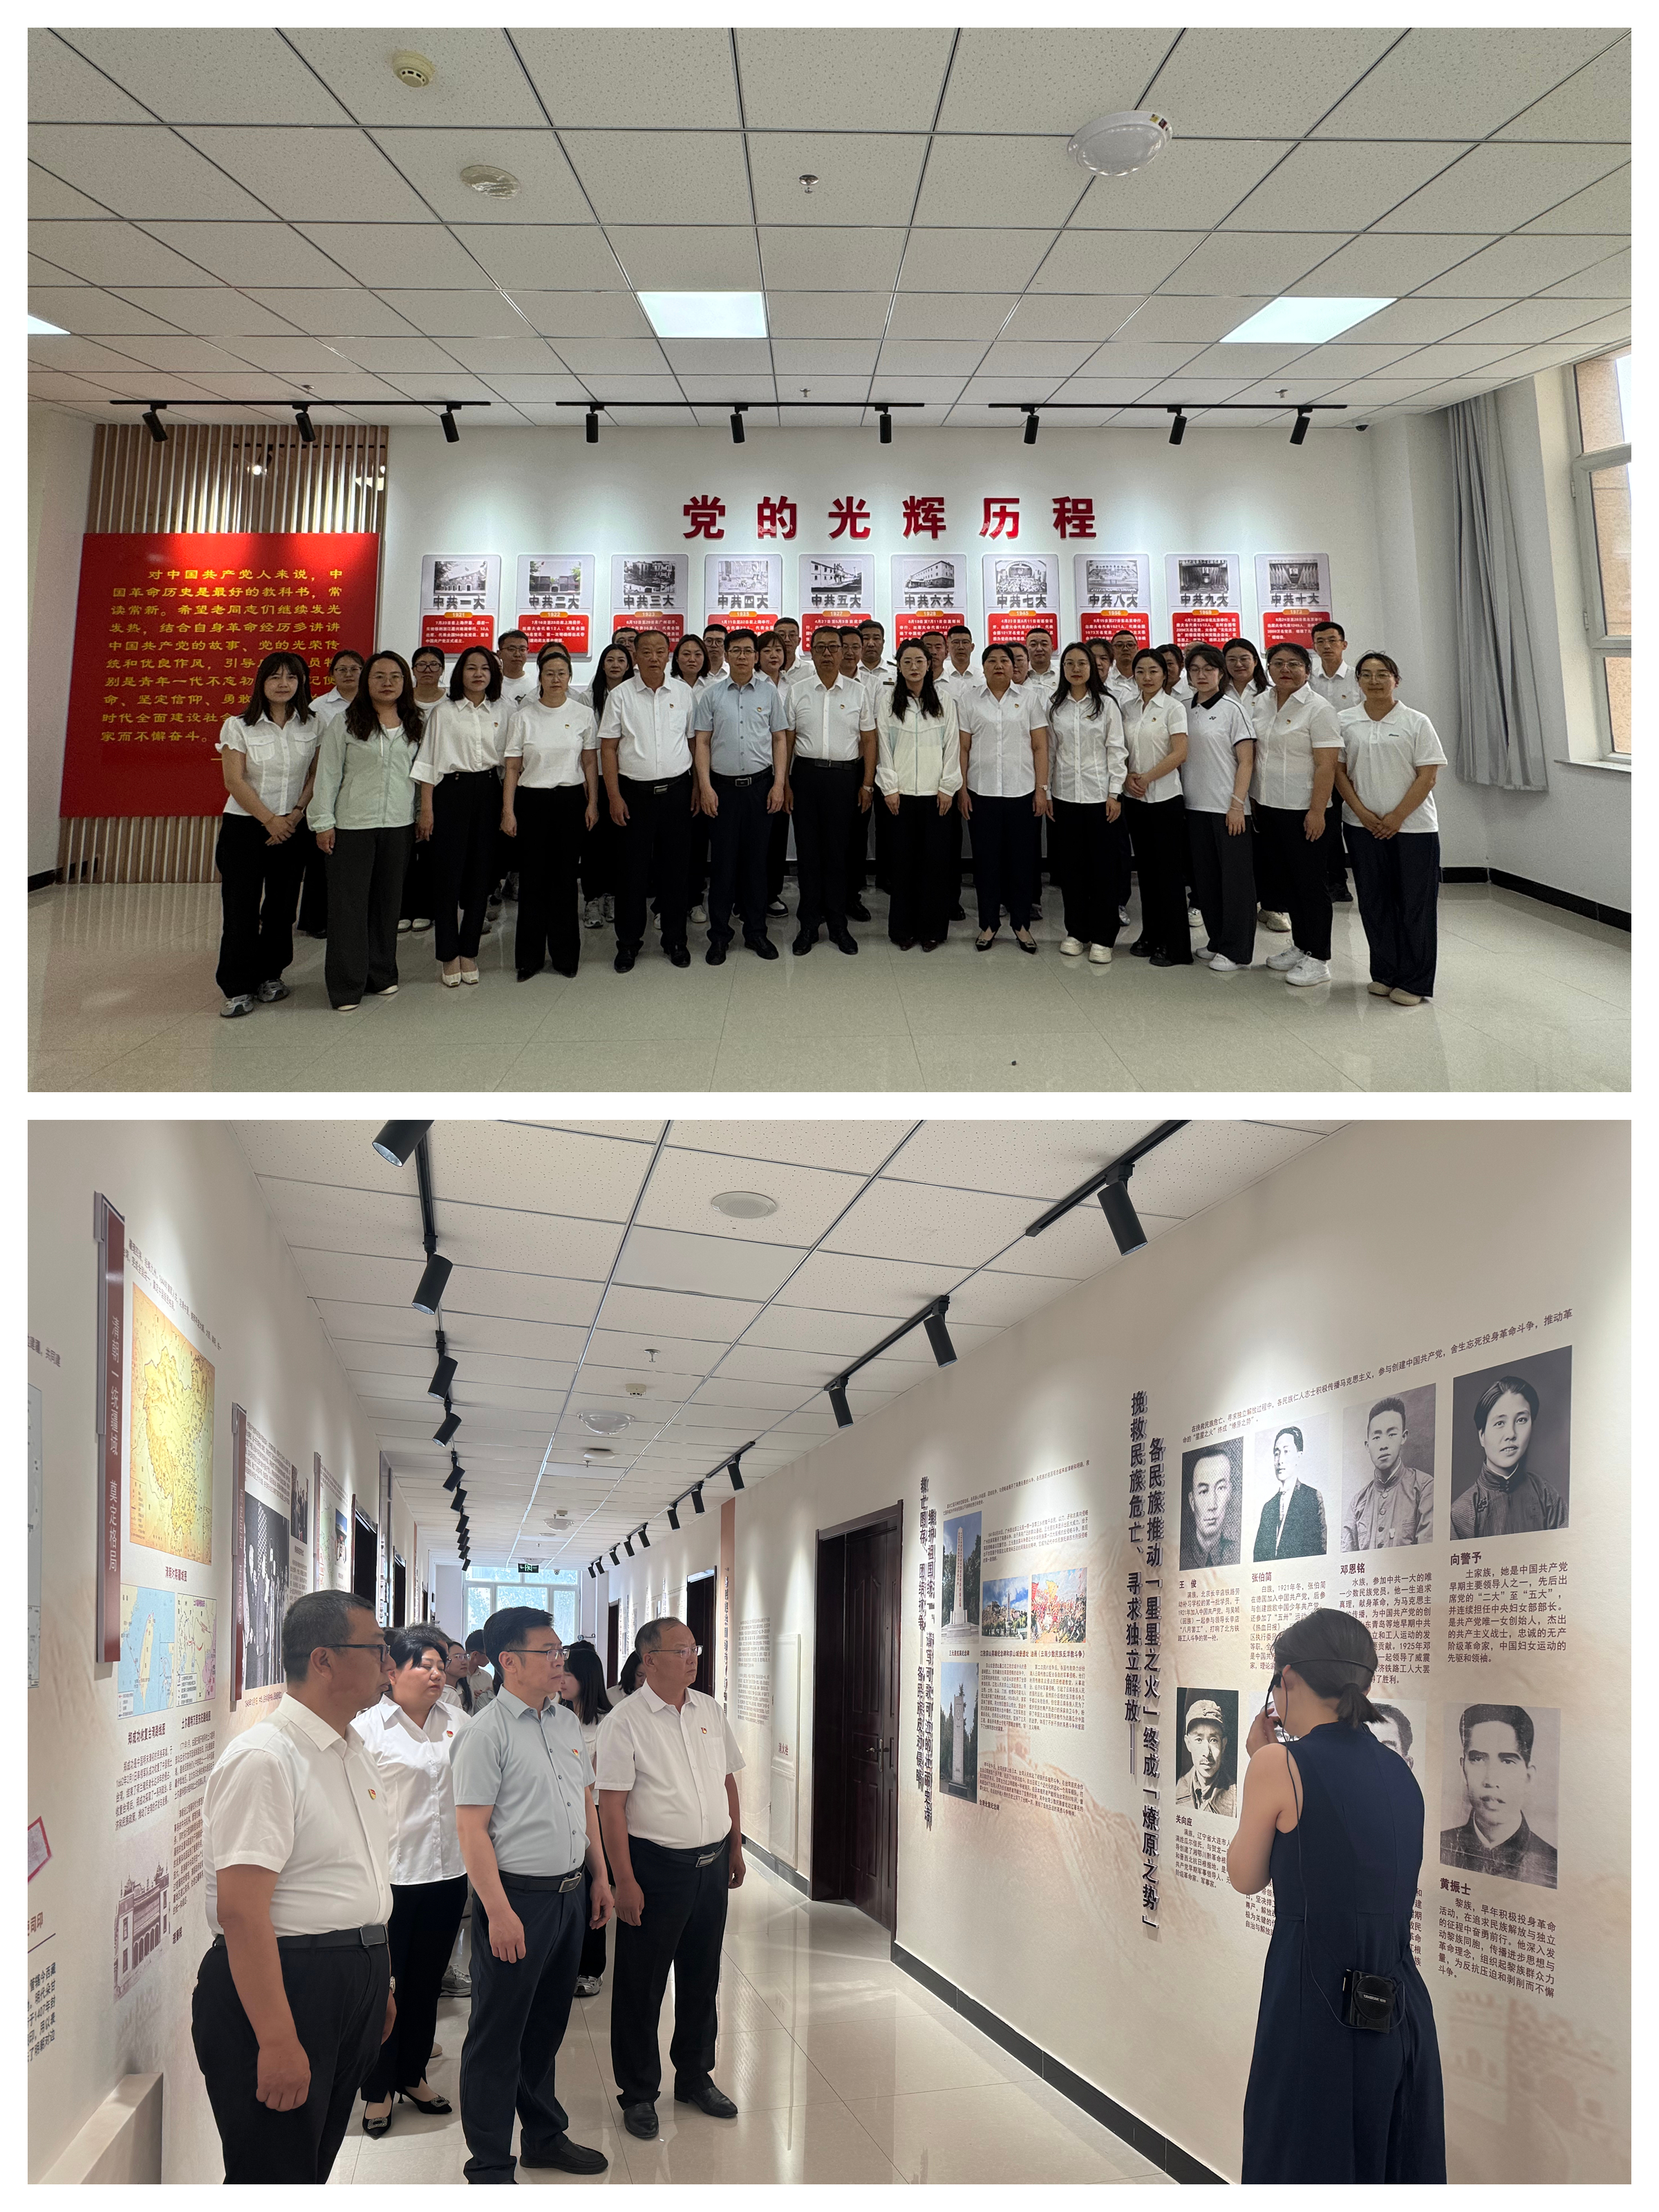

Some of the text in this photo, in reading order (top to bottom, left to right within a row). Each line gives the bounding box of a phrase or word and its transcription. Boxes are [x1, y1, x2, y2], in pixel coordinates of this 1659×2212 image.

[683, 495, 1096, 540] 党的光辉历程
[148, 568, 343, 581] 对中国共产党人来说，中
[113, 586, 342, 599] 国革命历史是最好的教科书，常
[433, 595, 485, 610] 中共一大
[529, 594, 579, 609] 中共二大
[624, 594, 674, 609] 中共三大
[812, 594, 861, 608] 中共五大
[905, 594, 955, 608] 中共六大
[997, 594, 1047, 608] 中共七大
[1089, 594, 1138, 608] 中共八大
[1181, 594, 1228, 608] 中共九大
[1270, 593, 1318, 608] 中共十大
[111, 603, 341, 617] 读常新。希望老同志们继续发光
[109, 621, 340, 635] 发热，结合自身革命经历多讲讲
[109, 639, 339, 653] 中国共产党的故事、党的光荣传
[101, 731, 207, 742] 家而不懈奋斗。
[109, 1480, 118, 1573] 奠定格局
[1450, 1552, 1482, 1566] 向警予
[1340, 1562, 1365, 1575] 邓恩铭
[1465, 1562, 1568, 1578] 土家族，她是中国共产党
[1252, 1572, 1272, 1582] 张伯简
[1352, 1573, 1432, 1586] 水族，参加中共一大的唯
[1450, 1575, 1567, 1591] 早期主要领导人之一，先后出
[1187, 1588, 1240, 1598] 满族，北京长辛店铁路劳
[1262, 1581, 1326, 1593] 白族，1921年冬，张伯简
[1340, 1584, 1432, 1597] 一少数民族党员。他一生追求
[1179, 1597, 1240, 1607] 动补习学校的第一批学员，于
[1251, 1591, 1326, 1603] 在德国加入中国共产党，后参
[1340, 1595, 1432, 1609] 真理，献身革命，为马克思主
[1449, 1588, 1562, 1603] 席党的“二大”至“五大”，
[1449, 1602, 1562, 1615] 并连续担任中央妇女部部长。
[1363, 1619, 1431, 1629] 东青岛等地早期中共
[1448, 1614, 1566, 1627] 是共产党唯一女创始人，杰出
[1448, 1627, 1566, 1638] 的共产主义战士，忠诚的无产
[1448, 1641, 1566, 1651] 阶级革命家，中国妇女运动的
[1378, 1653, 1430, 1662] 一起领导了威震
[1447, 1653, 1492, 1662] 先驱和领袖。
[127, 1723, 166, 1745] 郑成功收复台湾路线图
[1176, 1815, 1192, 1826] 关向应
[1175, 1835, 1228, 1854] 满姓瓜尔佳氏，与贺龙一
[1440, 1877, 1471, 1895] 黄振士
[1455, 1897, 1556, 1933] 黎族，早年积极投身革命
[1439, 1906, 1555, 1946] 活动，在追求民族解放与独立
[1439, 1918, 1555, 1959] 的征程中奋勇前行。他深入发
[1439, 1930, 1555, 1971] 动黎族同胞，传播进步思想与
[1438, 1941, 1555, 1985] 革命理念，组织起黎族群众力
[1438, 1965, 1457, 1978] 斗争。
[1438, 1953, 1554, 1998] 量，为反抗压迫和剥削而不懈
[28, 1994, 56, 2029] 于1407年封
[28, 2029, 55, 2063] 了明朝对边
